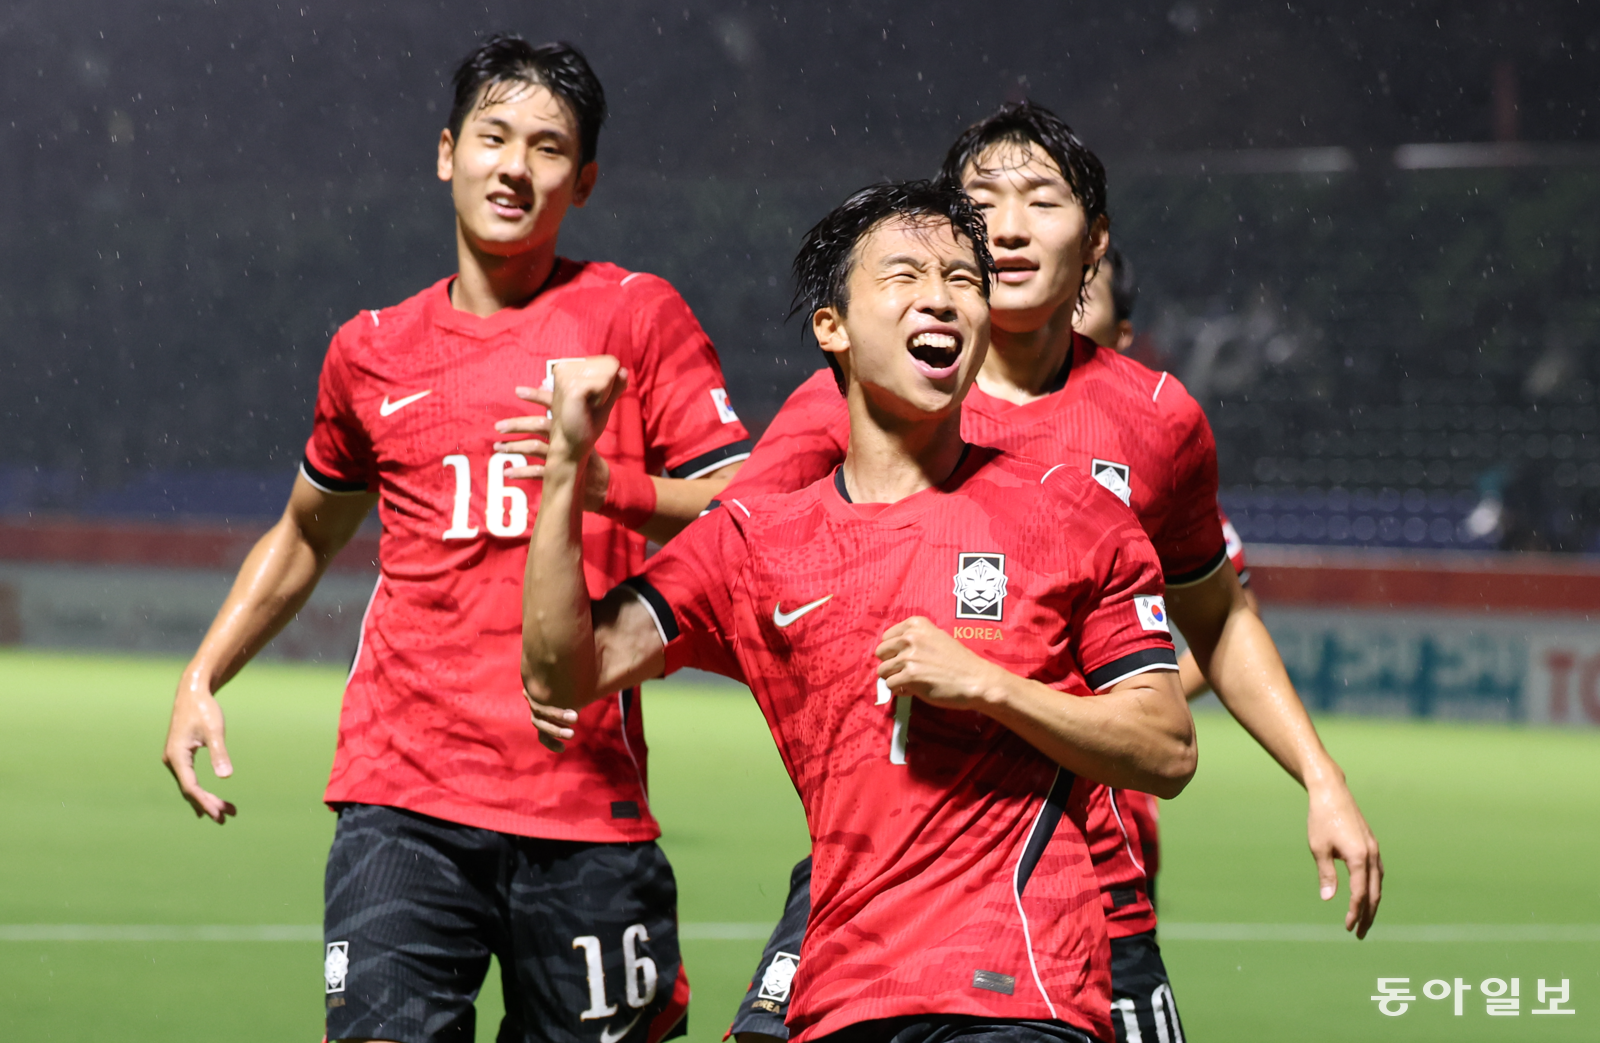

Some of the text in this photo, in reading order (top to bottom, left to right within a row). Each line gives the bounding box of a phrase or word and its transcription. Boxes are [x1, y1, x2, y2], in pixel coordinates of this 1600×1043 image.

[442, 452, 529, 541] 16
[953, 626, 1004, 641] KOREA
[572, 923, 659, 1022] 16
